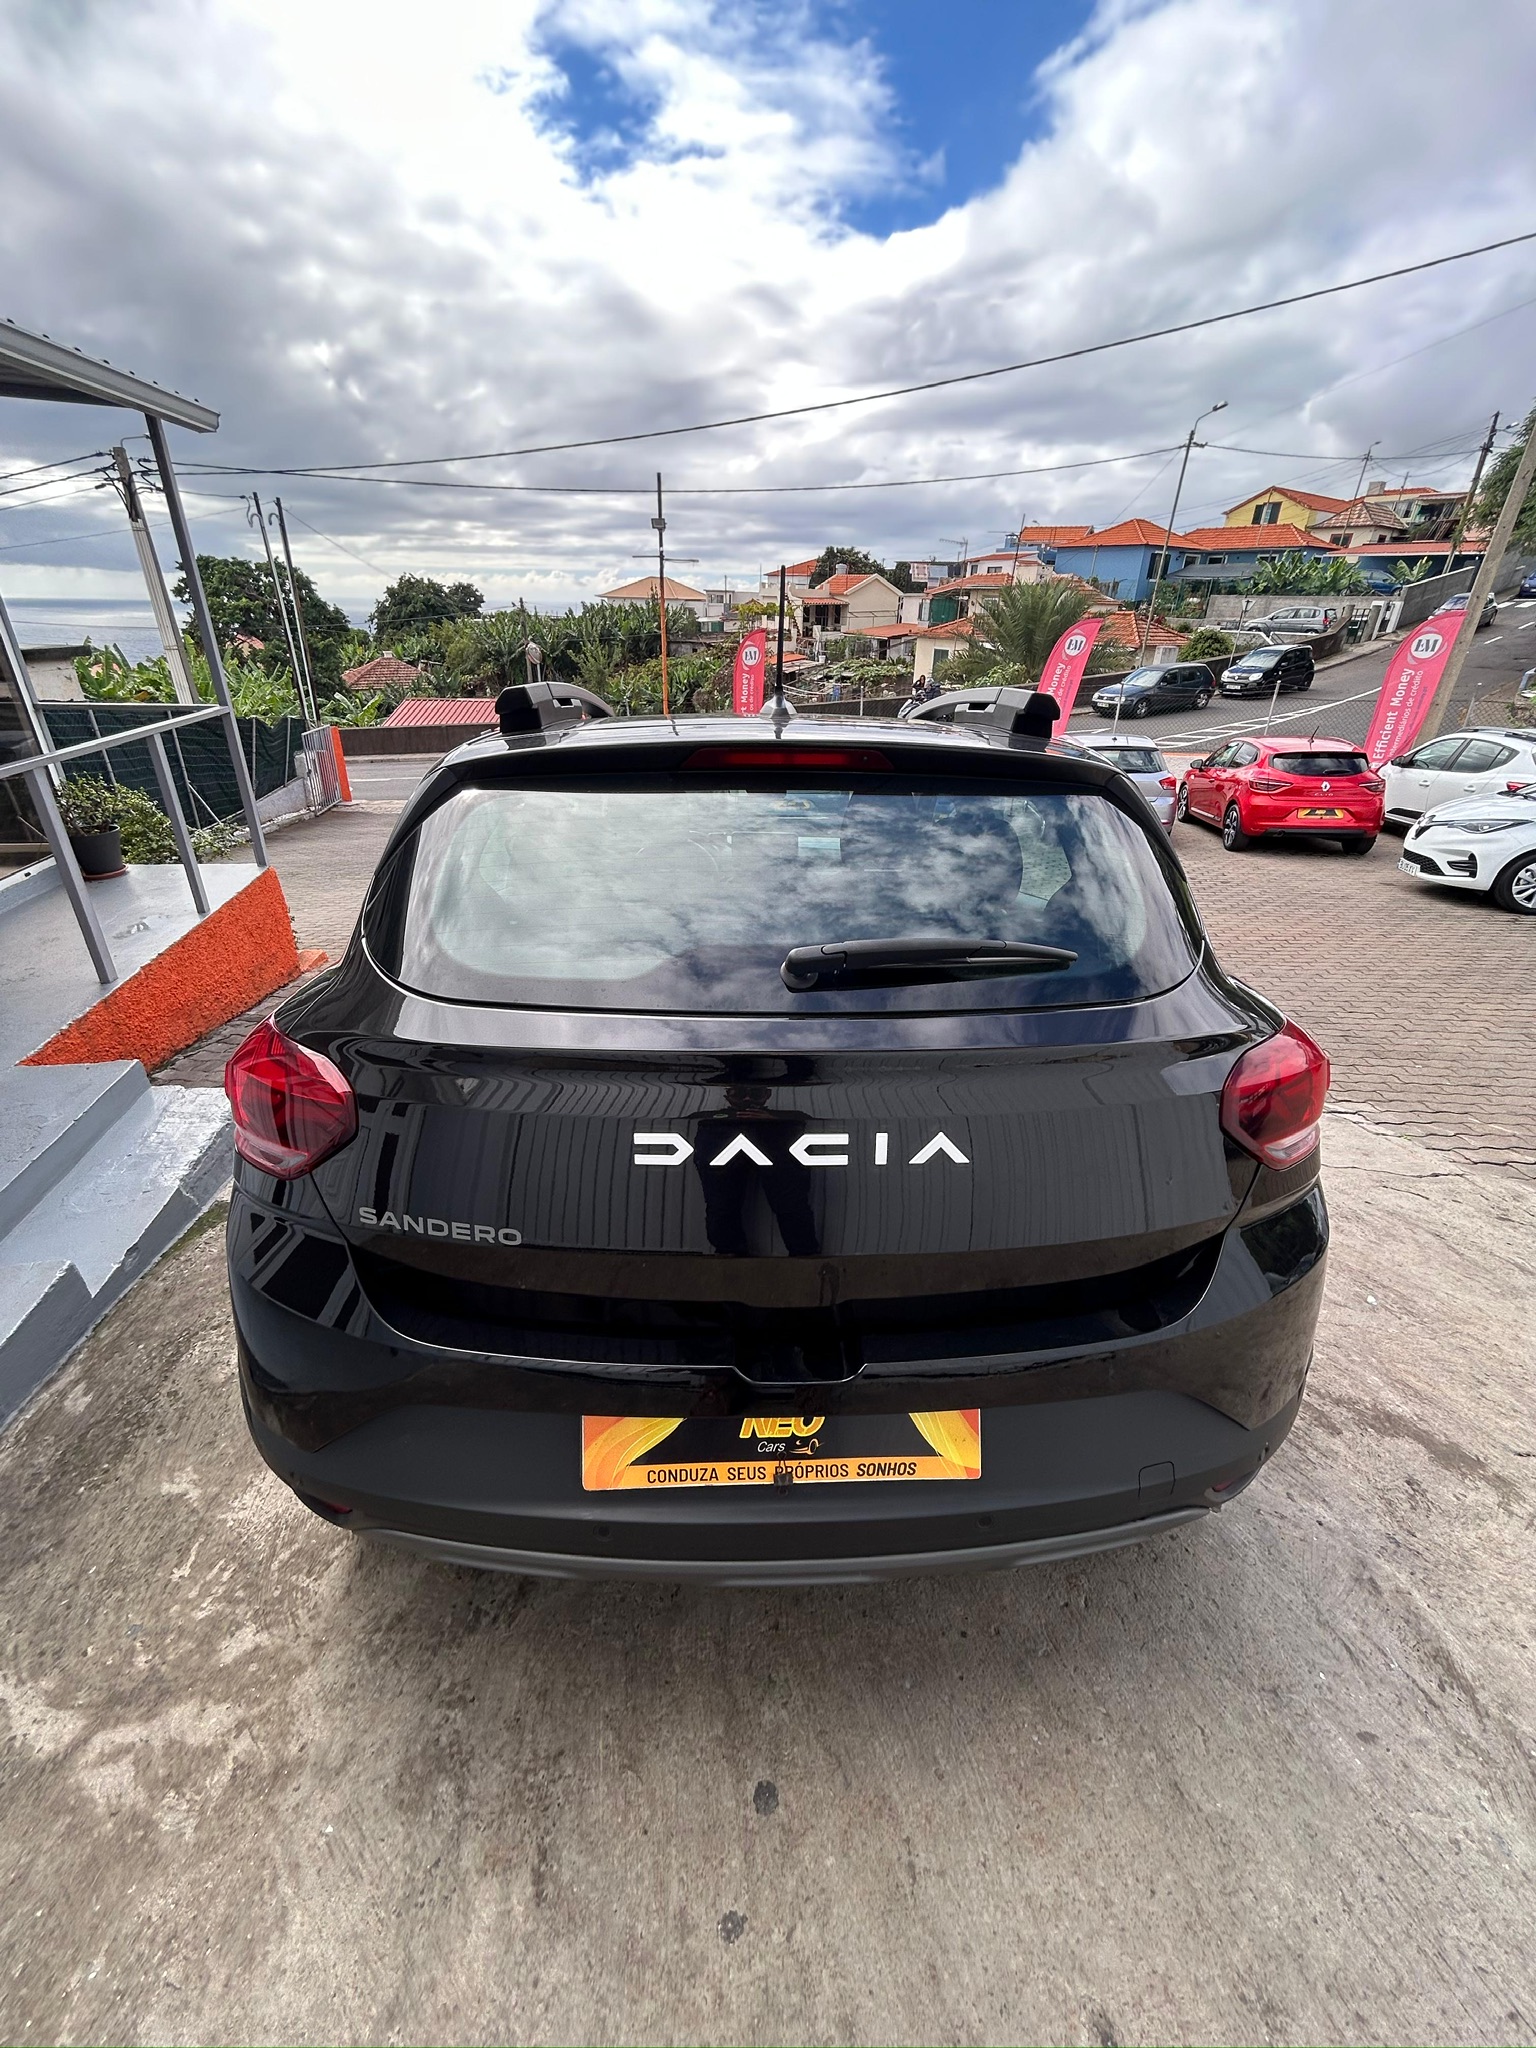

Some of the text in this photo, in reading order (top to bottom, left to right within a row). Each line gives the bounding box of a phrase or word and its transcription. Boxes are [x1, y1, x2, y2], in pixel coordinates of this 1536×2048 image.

[740, 673, 750, 703] Money
[1410, 670, 1424, 693] crédito
[1405, 691, 1416, 706] de
[1372, 668, 1415, 759] Efficient Money
[633, 1131, 970, 1166] DACIA
[359, 1206, 522, 1246] SANDERO
[739, 1416, 826, 1439] NEO
[757, 1441, 786, 1453] Cars
[647, 1467, 719, 1484] CONDUZA
[727, 1466, 767, 1481] SEUS
[856, 1462, 917, 1477] SONHOS
